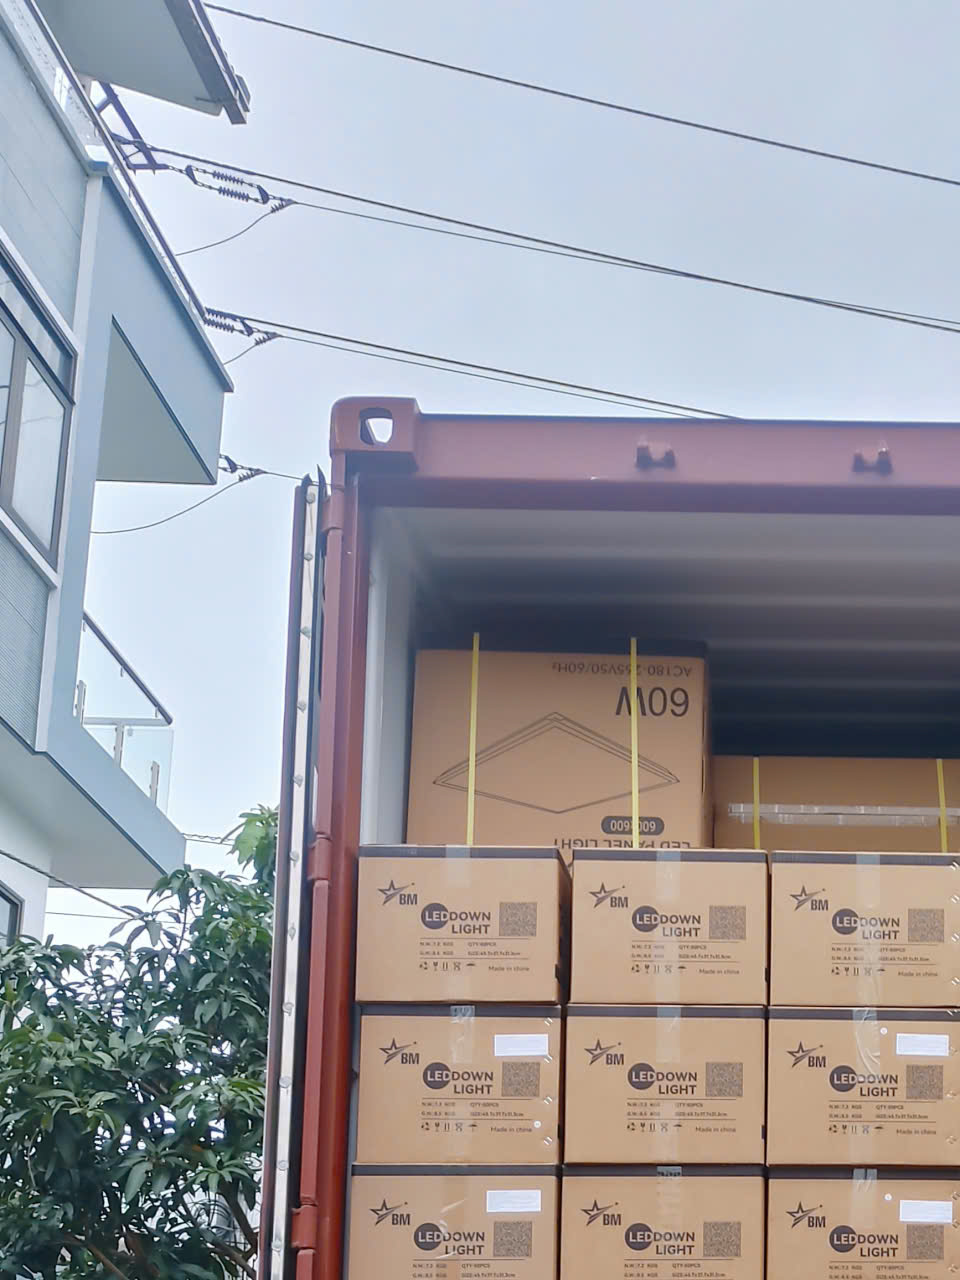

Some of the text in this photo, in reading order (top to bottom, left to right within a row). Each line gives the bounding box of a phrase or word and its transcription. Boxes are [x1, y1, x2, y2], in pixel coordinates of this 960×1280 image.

[616, 687, 689, 716] 60W
[610, 820, 656, 832] 600600
[399, 893, 418, 905] BM
[610, 896, 628, 908] BM
[811, 899, 829, 911] BM
[451, 924, 491, 934] LIGHT
[661, 927, 700, 937] LIGHT
[401, 1052, 419, 1065] BM
[606, 1053, 624, 1065] BM
[808, 1055, 826, 1068] BM
[454, 1084, 493, 1094] LIGHT
[658, 1084, 697, 1095] LIGHT
[391, 1213, 411, 1226] BM
[602, 1213, 622, 1226] BM
[807, 1216, 826, 1228] BM
[445, 1245, 484, 1255] LIGHT
[656, 1244, 694, 1255] LIGHT
[860, 1247, 898, 1257] LIGHT
